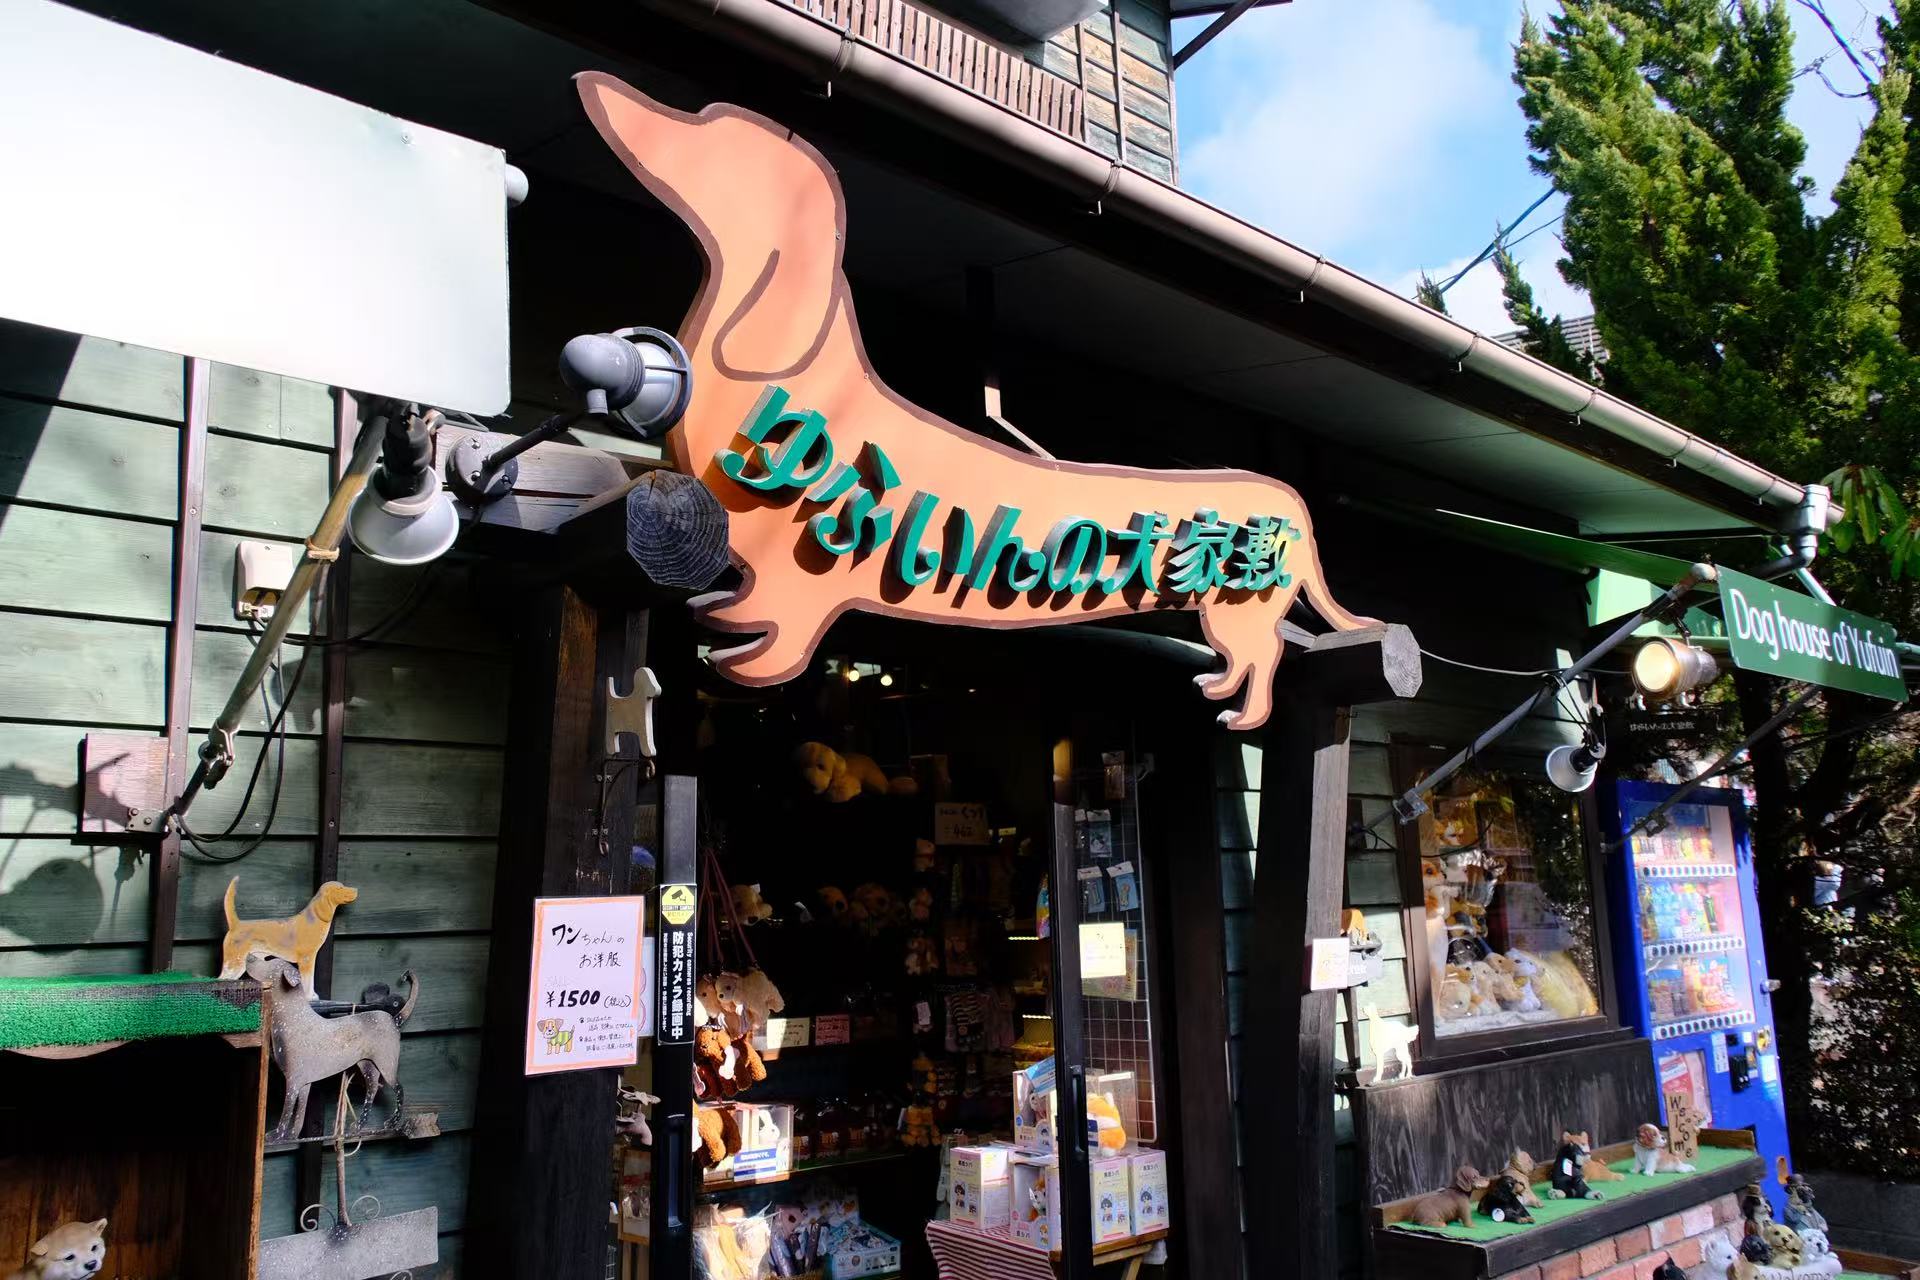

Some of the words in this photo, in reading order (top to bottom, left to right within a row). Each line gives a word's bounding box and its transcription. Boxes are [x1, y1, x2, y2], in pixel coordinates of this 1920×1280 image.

[714, 384, 1301, 595] ゆふいんの犬家敷
[1728, 588, 1780, 661] Dog
[1773, 600, 1833, 662] house
[1832, 621, 1851, 666] of
[1846, 625, 1900, 679] Yufuin
[551, 923, 625, 946] ワンちゃんの
[686, 932, 694, 957] Security
[579, 951, 622, 968] お洋服
[546, 989, 601, 1008] ¥1500
[671, 931, 685, 1040] 防犯カメラ録画中
[685, 987, 693, 1017] recording
